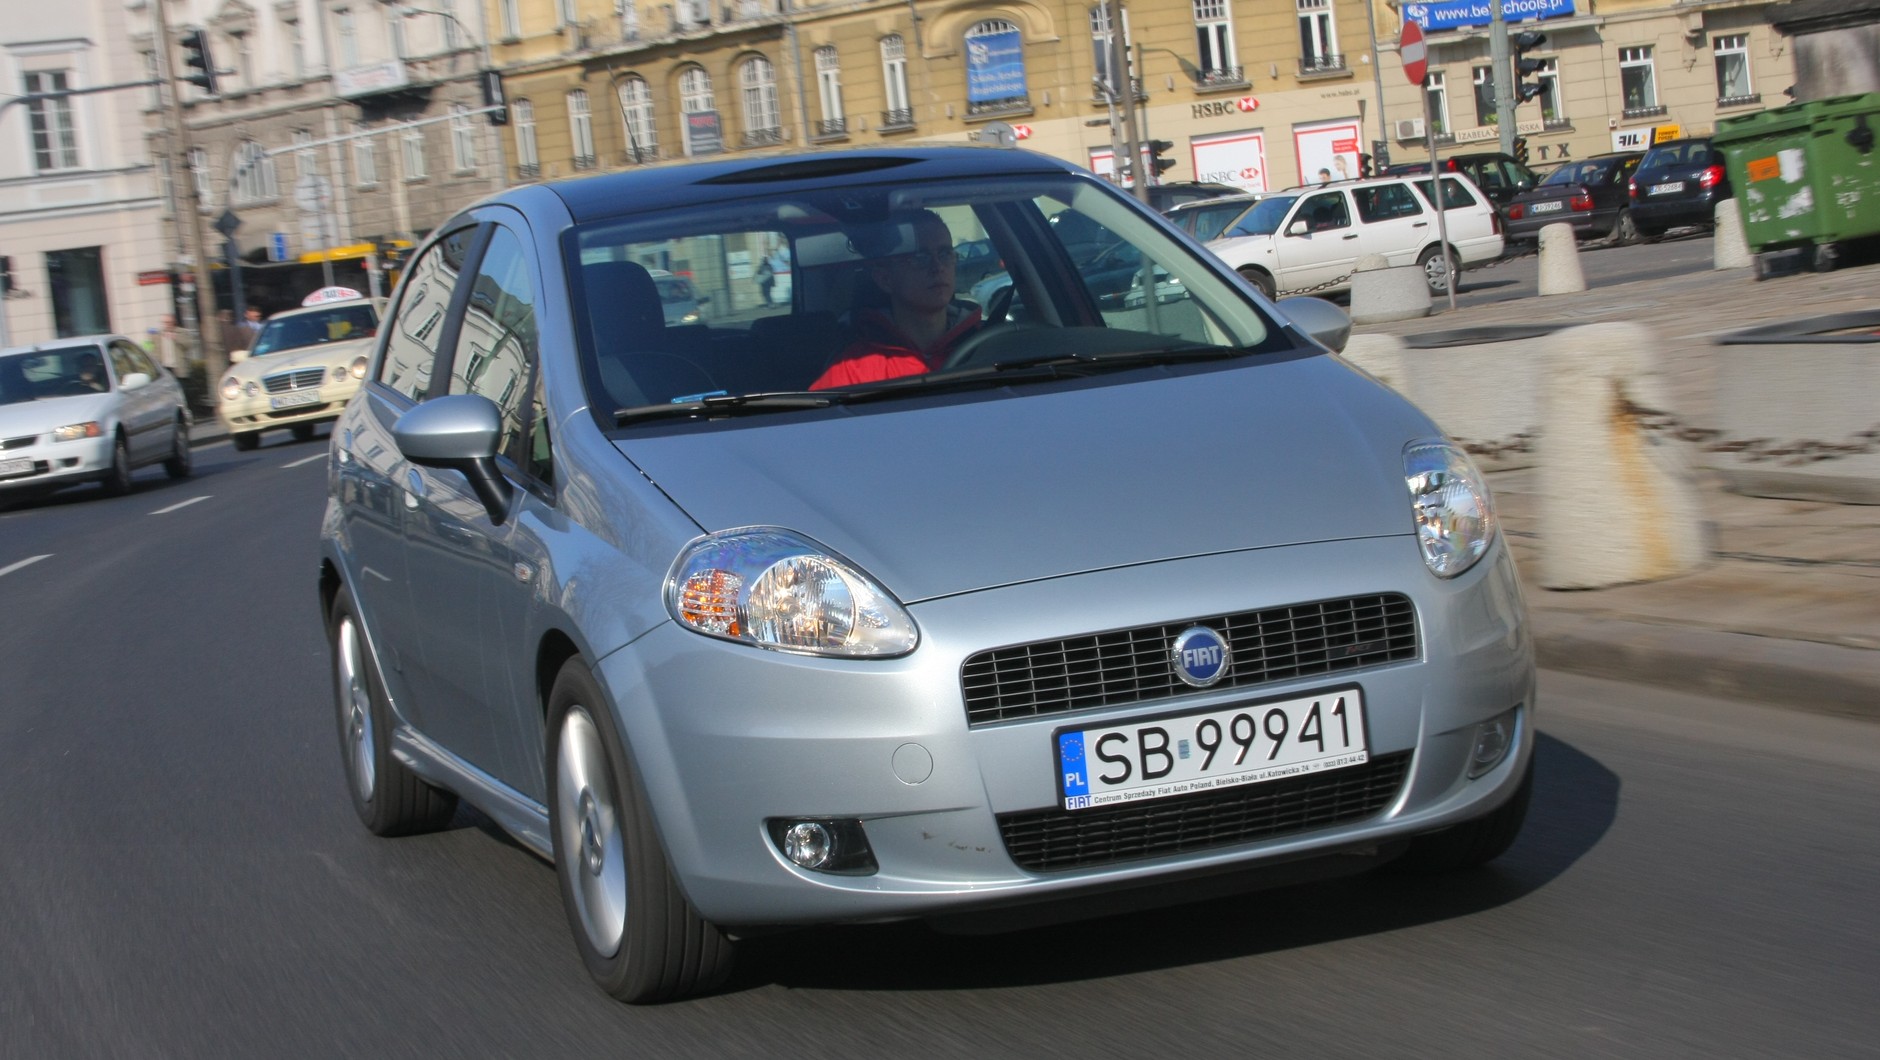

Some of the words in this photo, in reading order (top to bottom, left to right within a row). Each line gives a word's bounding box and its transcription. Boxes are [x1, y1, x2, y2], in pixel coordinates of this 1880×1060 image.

[1191, 101, 1235, 119] HSBC
[1458, 129, 1491, 140] IZABELA
[1200, 170, 1237, 183] HSBC
[1182, 645, 1220, 669] FIAT
[1094, 726, 1174, 785] SB
[1195, 696, 1350, 771] 99941
[1065, 773, 1084, 787] PL
[1068, 796, 1091, 809] FIAT
[1094, 794, 1122, 804] Centrum
[1123, 788, 1155, 801] Sprzedaży
[1158, 784, 1171, 794] Fiat
[1173, 782, 1188, 793] Auto
[1216, 774, 1258, 787] Bielsko-Biała
